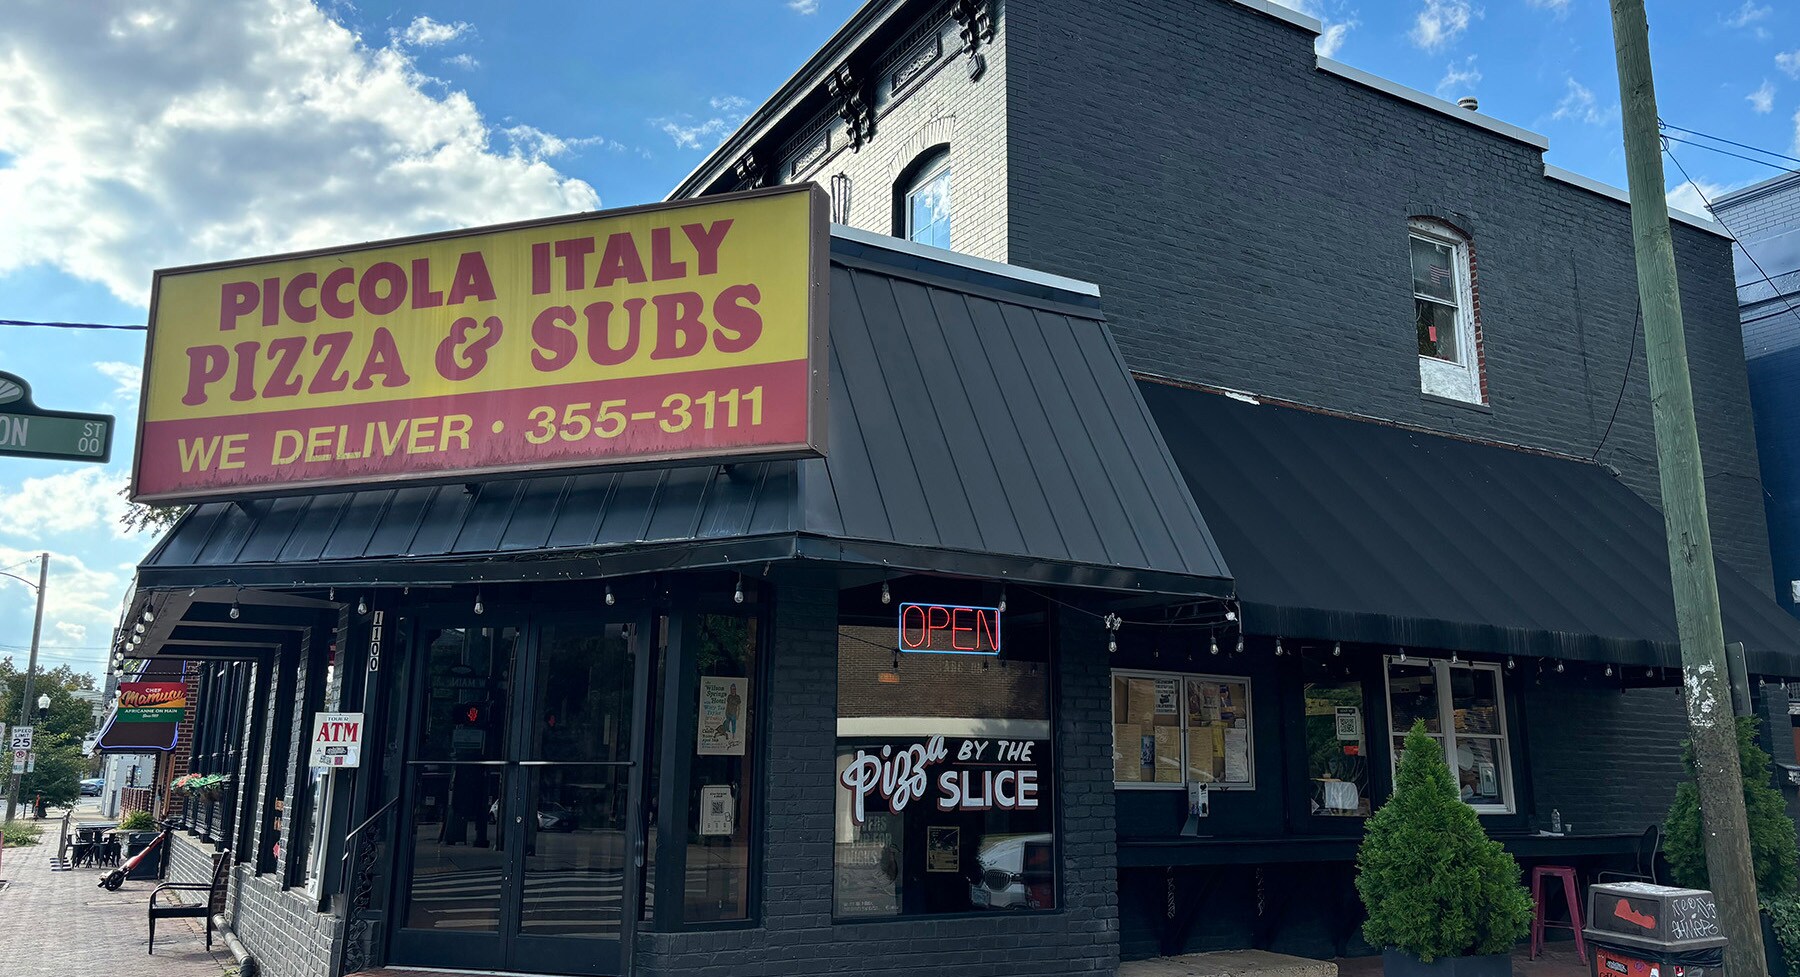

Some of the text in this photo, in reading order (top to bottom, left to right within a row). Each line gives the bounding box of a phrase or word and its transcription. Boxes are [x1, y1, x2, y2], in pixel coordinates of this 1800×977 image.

[220, 219, 735, 331] PICCOLA ITALY
[181, 283, 763, 406] PIZZA & SUBS
[78, 438, 100, 453] 00
[83, 422, 103, 438] ST
[177, 386, 763, 473] WE DELIVER 355-3111
[369, 612, 383, 671] 1100
[902, 605, 999, 652] OPEN
[13, 738, 30, 747] 25
[316, 722, 359, 742] ATM
[841, 733, 948, 825] Pizza
[957, 740, 988, 761] BY
[997, 740, 1034, 762] THE
[937, 770, 1039, 811] SLICE
